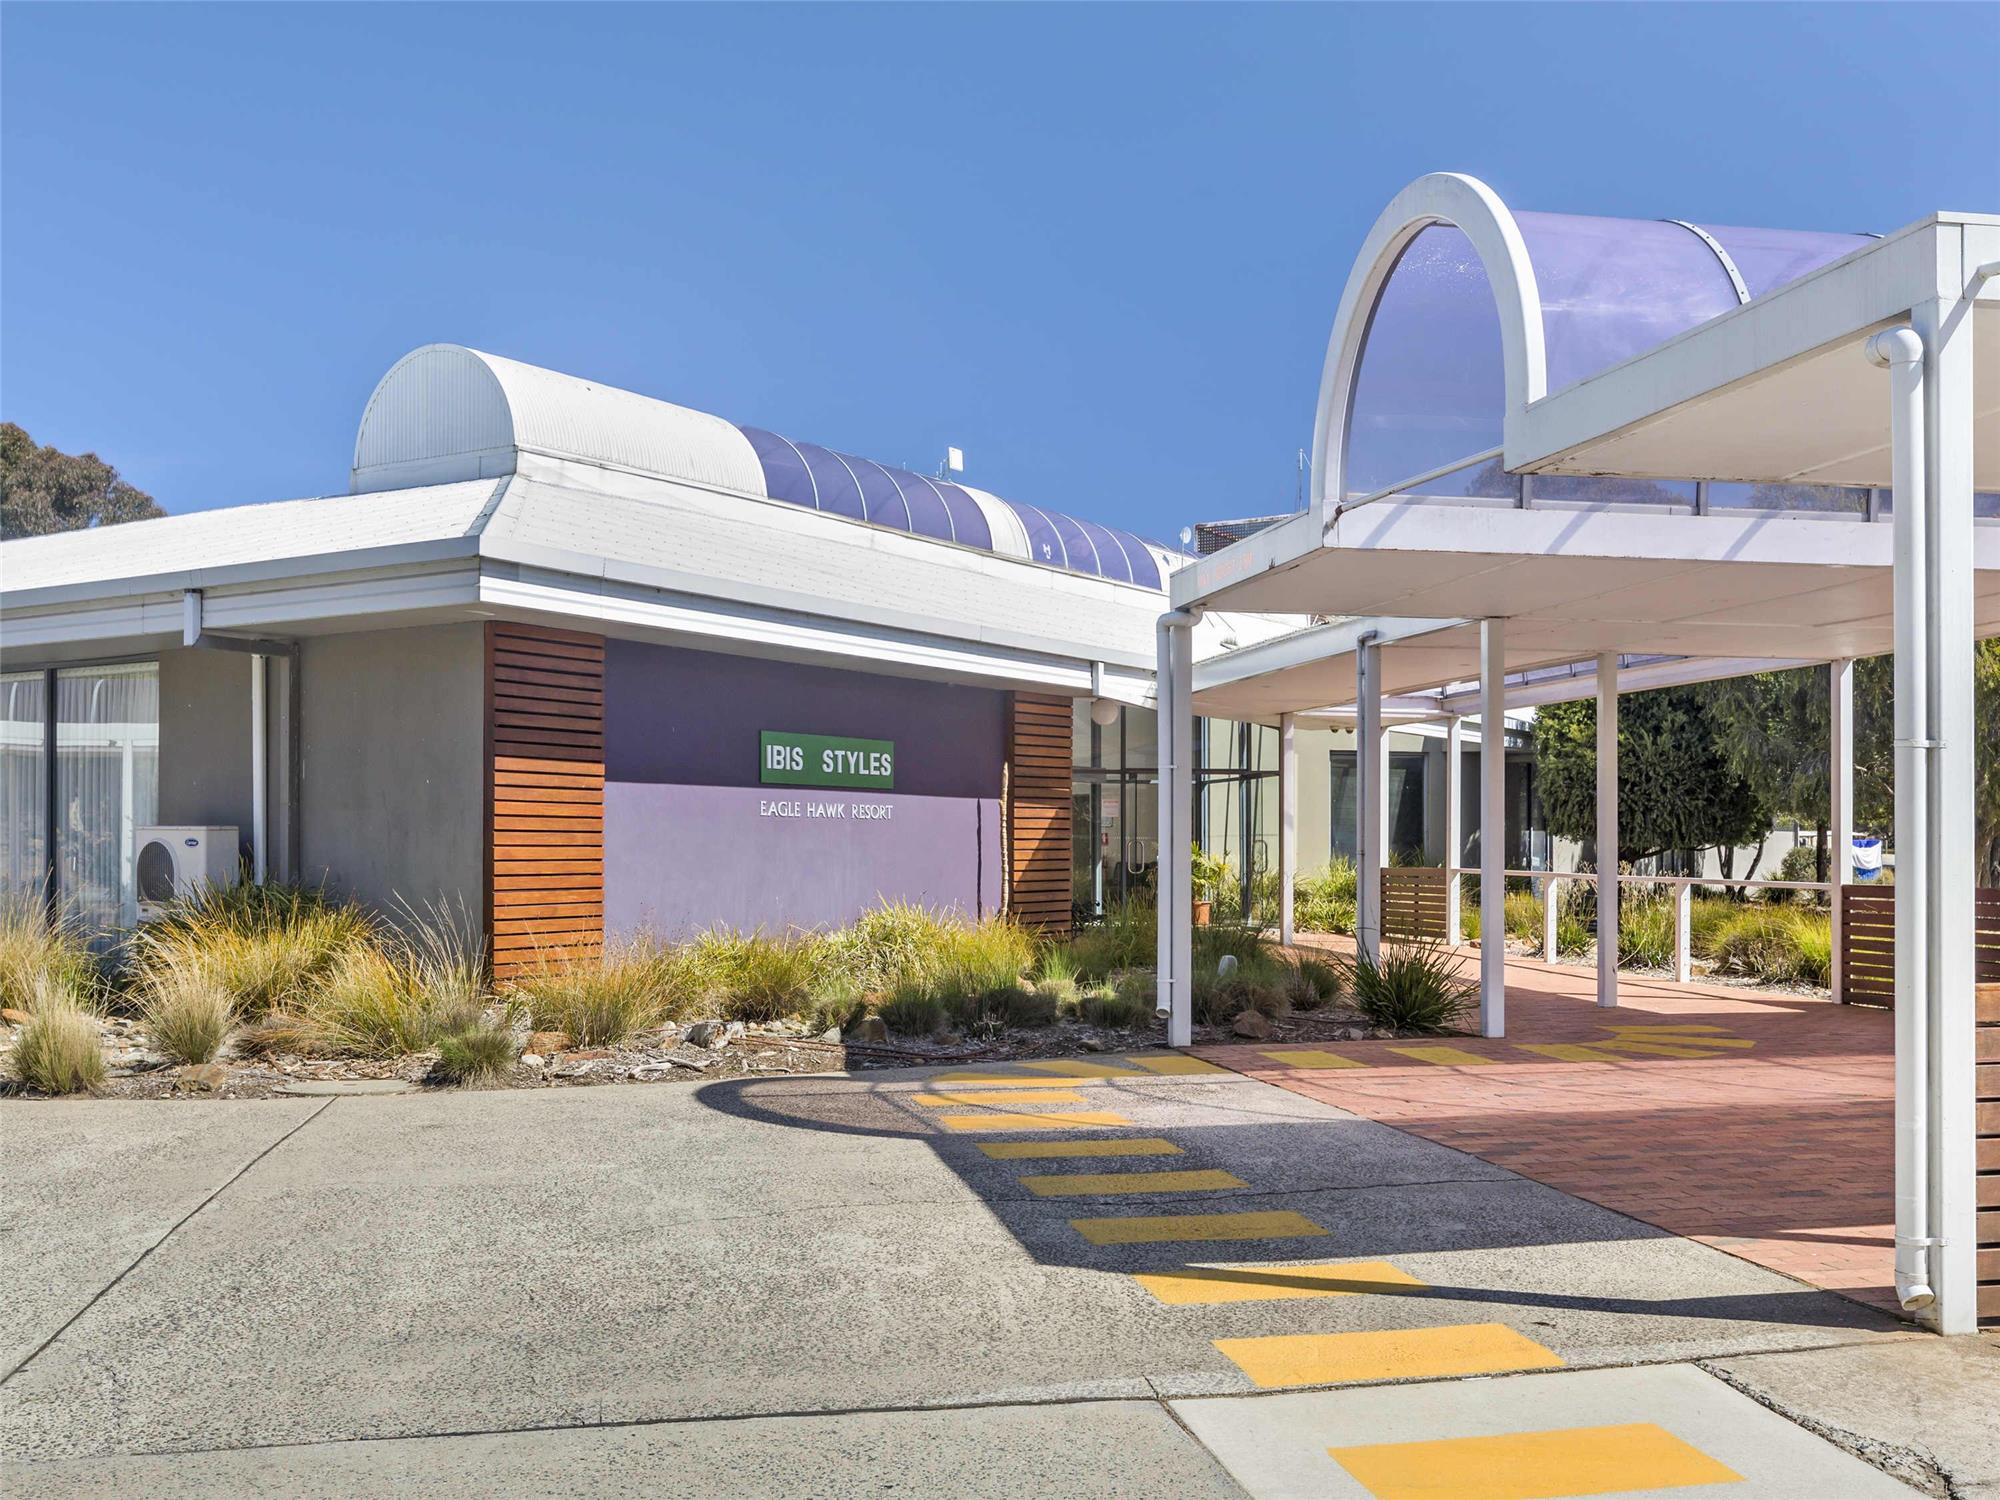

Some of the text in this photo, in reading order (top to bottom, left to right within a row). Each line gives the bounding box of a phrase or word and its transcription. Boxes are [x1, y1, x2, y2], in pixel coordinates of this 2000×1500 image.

[766, 744, 892, 776] IBIS STYLES
[760, 801, 893, 819] EAGLE HAWK RESORT
